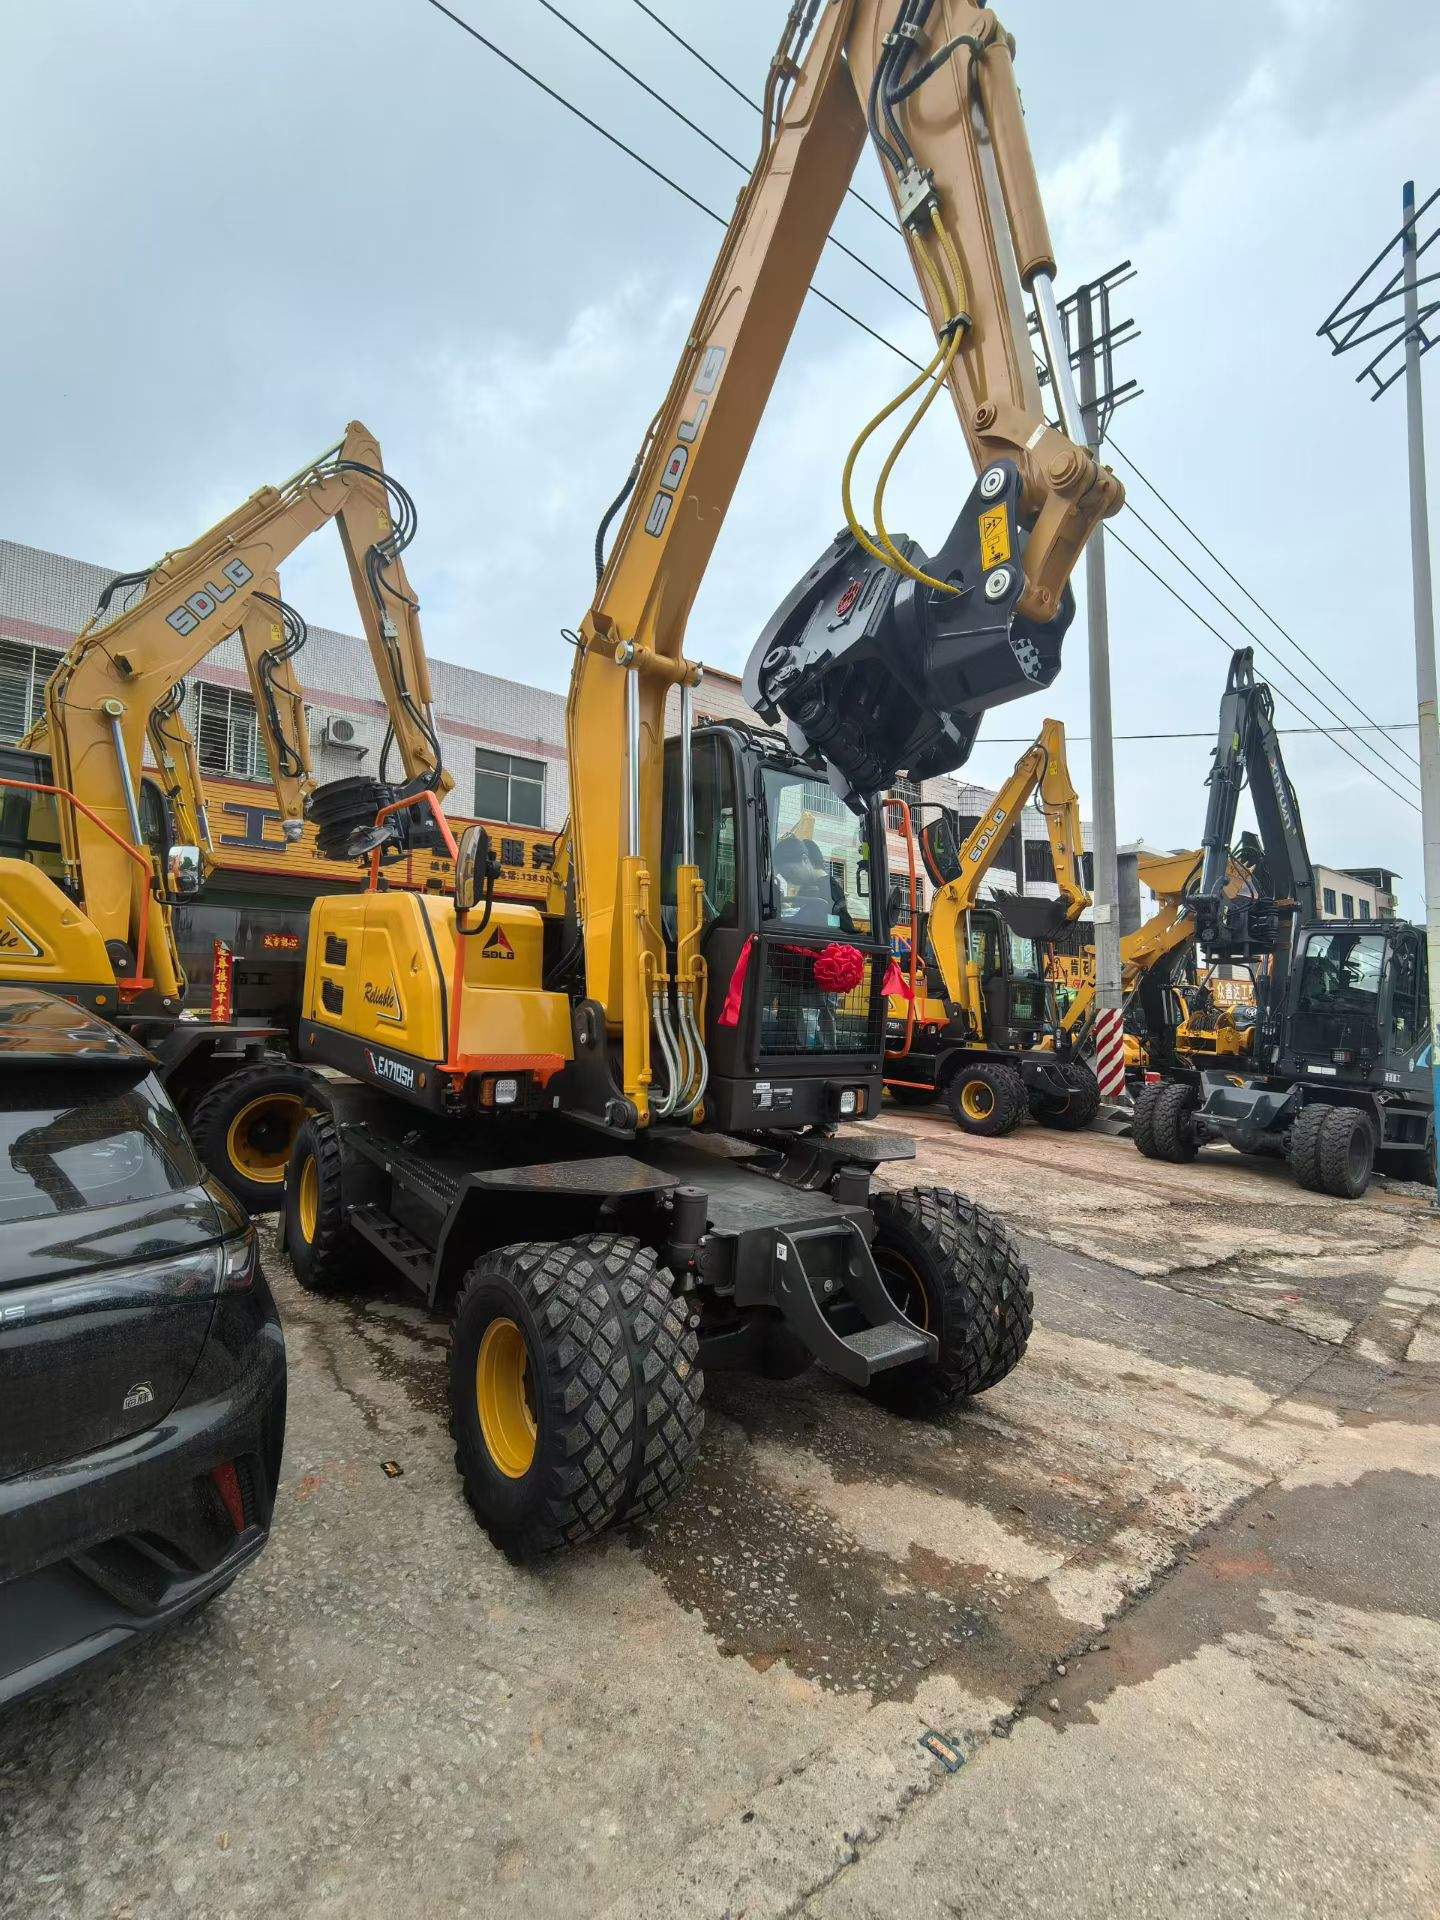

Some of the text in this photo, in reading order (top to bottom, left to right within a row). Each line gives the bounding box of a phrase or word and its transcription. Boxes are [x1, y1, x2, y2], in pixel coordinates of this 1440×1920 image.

[644, 345, 727, 538] SDLG
[165, 557, 254, 637] SDLG
[969, 808, 1007, 862] SDLG
[482, 950, 515, 960] SDLG
[363, 981, 395, 1009] Reliable
